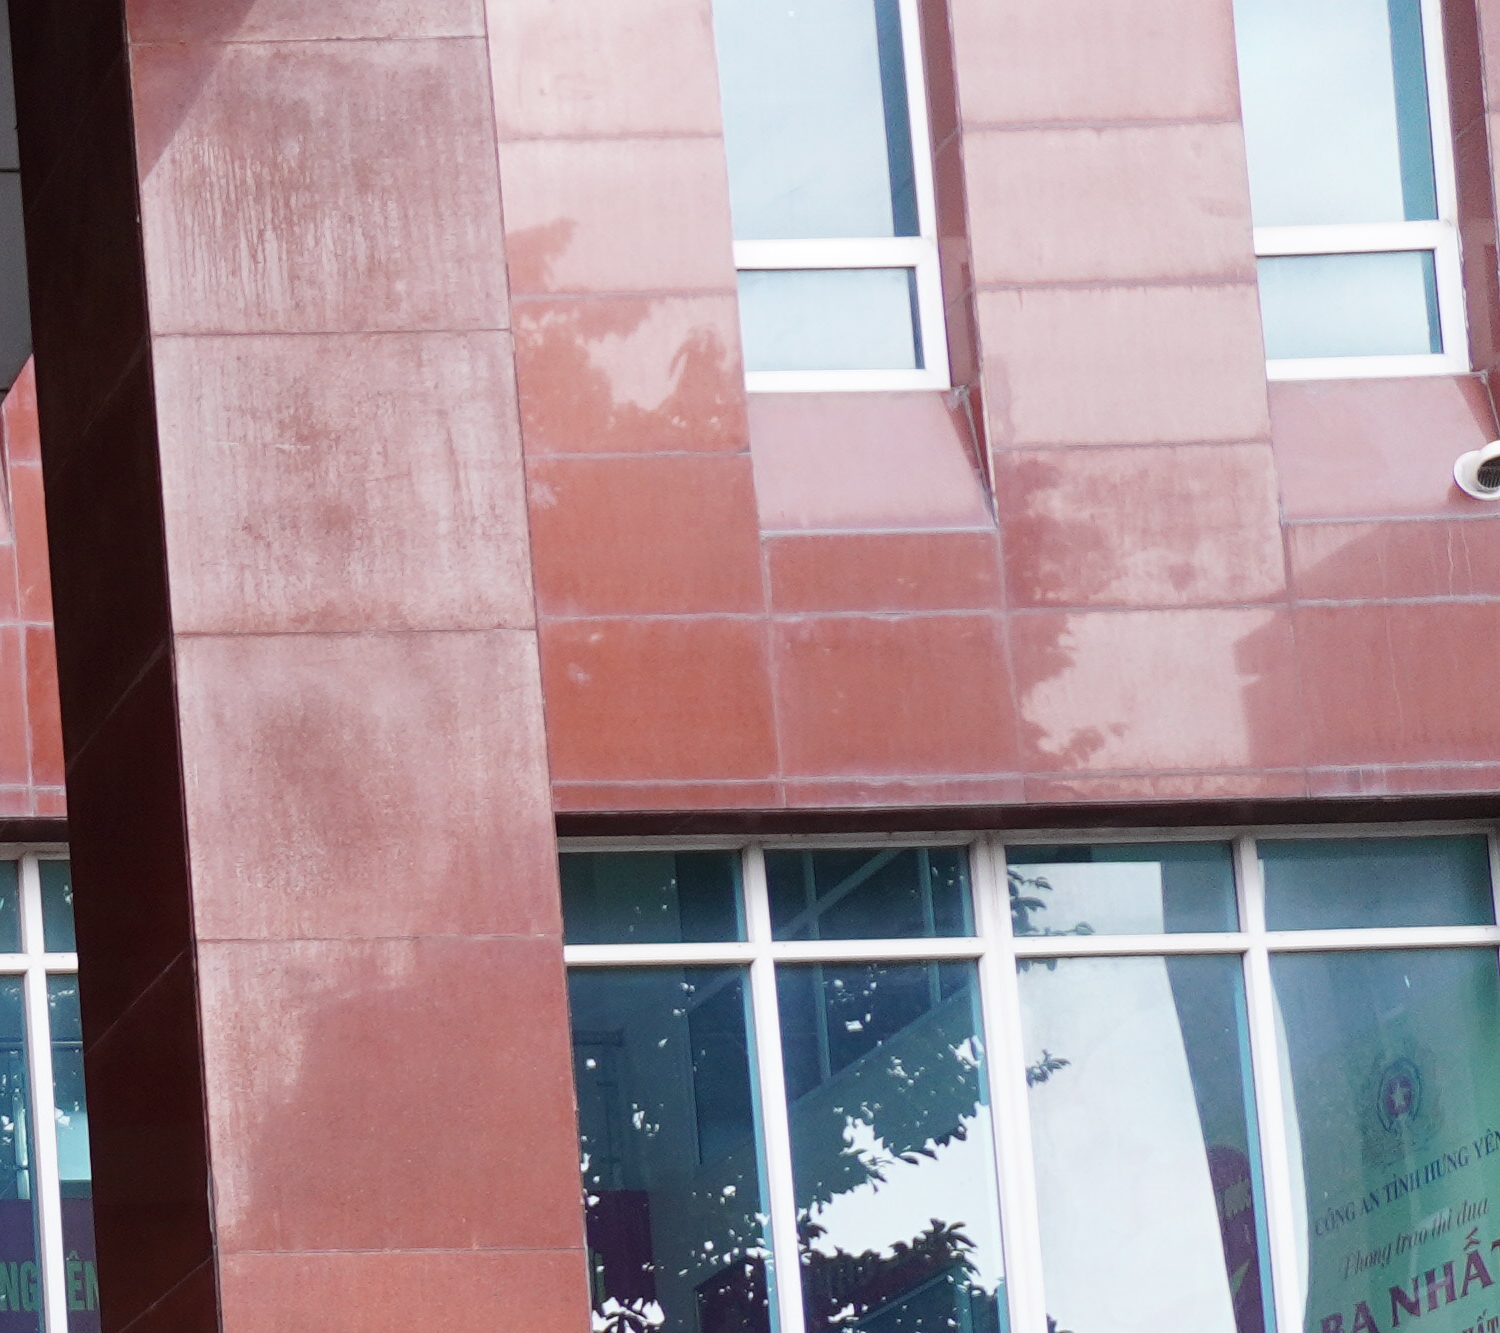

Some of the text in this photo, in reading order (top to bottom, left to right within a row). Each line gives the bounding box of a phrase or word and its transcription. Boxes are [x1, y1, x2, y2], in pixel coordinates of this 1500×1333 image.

[1315, 1201, 1356, 1237] CÔNG
[1362, 1187, 1381, 1214] AN
[1383, 1173, 1420, 1203] TỈNH
[1424, 1146, 1470, 1184] HƯNG
[1388, 1226, 1500, 1328] NHẤ
